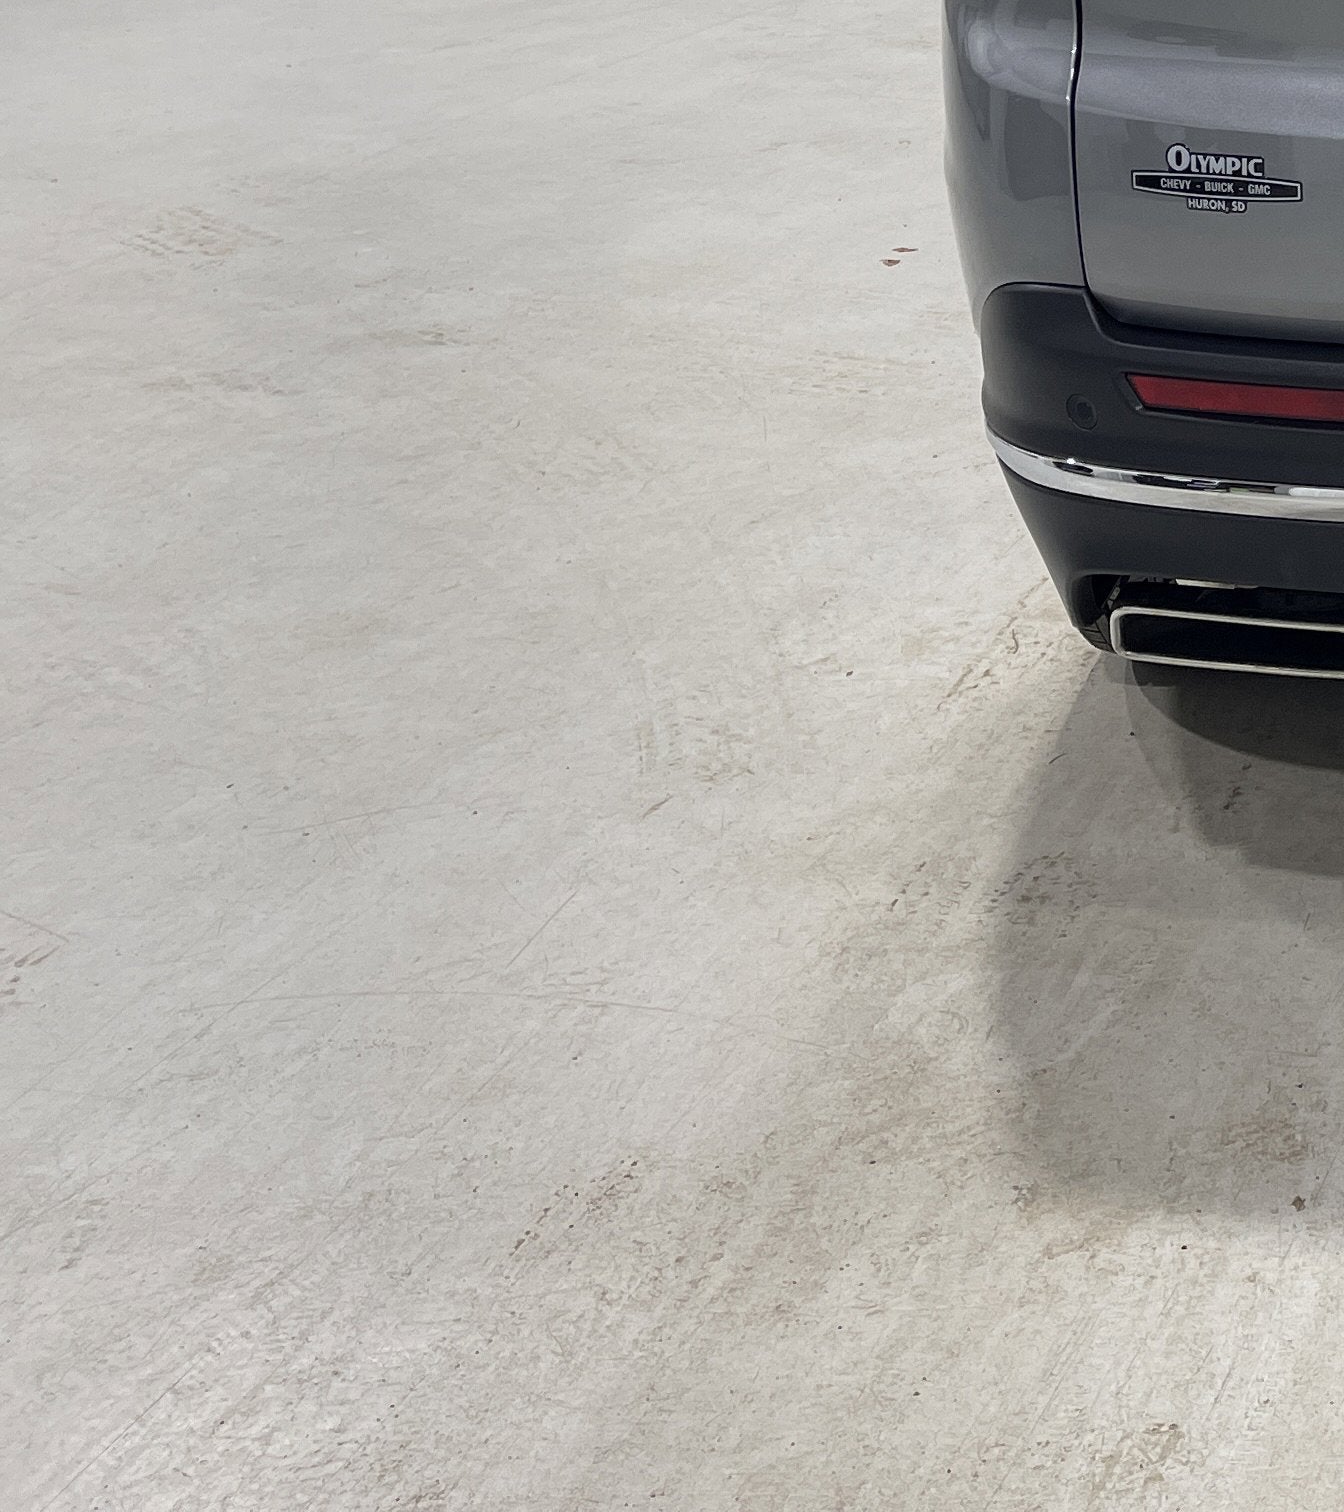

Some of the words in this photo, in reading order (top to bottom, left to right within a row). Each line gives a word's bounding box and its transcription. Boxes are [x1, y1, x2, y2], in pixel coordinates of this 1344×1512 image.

[1160, 178, 1191, 190] CHEVY
[1204, 181, 1235, 193] BUICK
[1247, 183, 1271, 195] GMC
[1188, 198, 1229, 212] HURON,
[1231, 200, 1246, 212] SD
